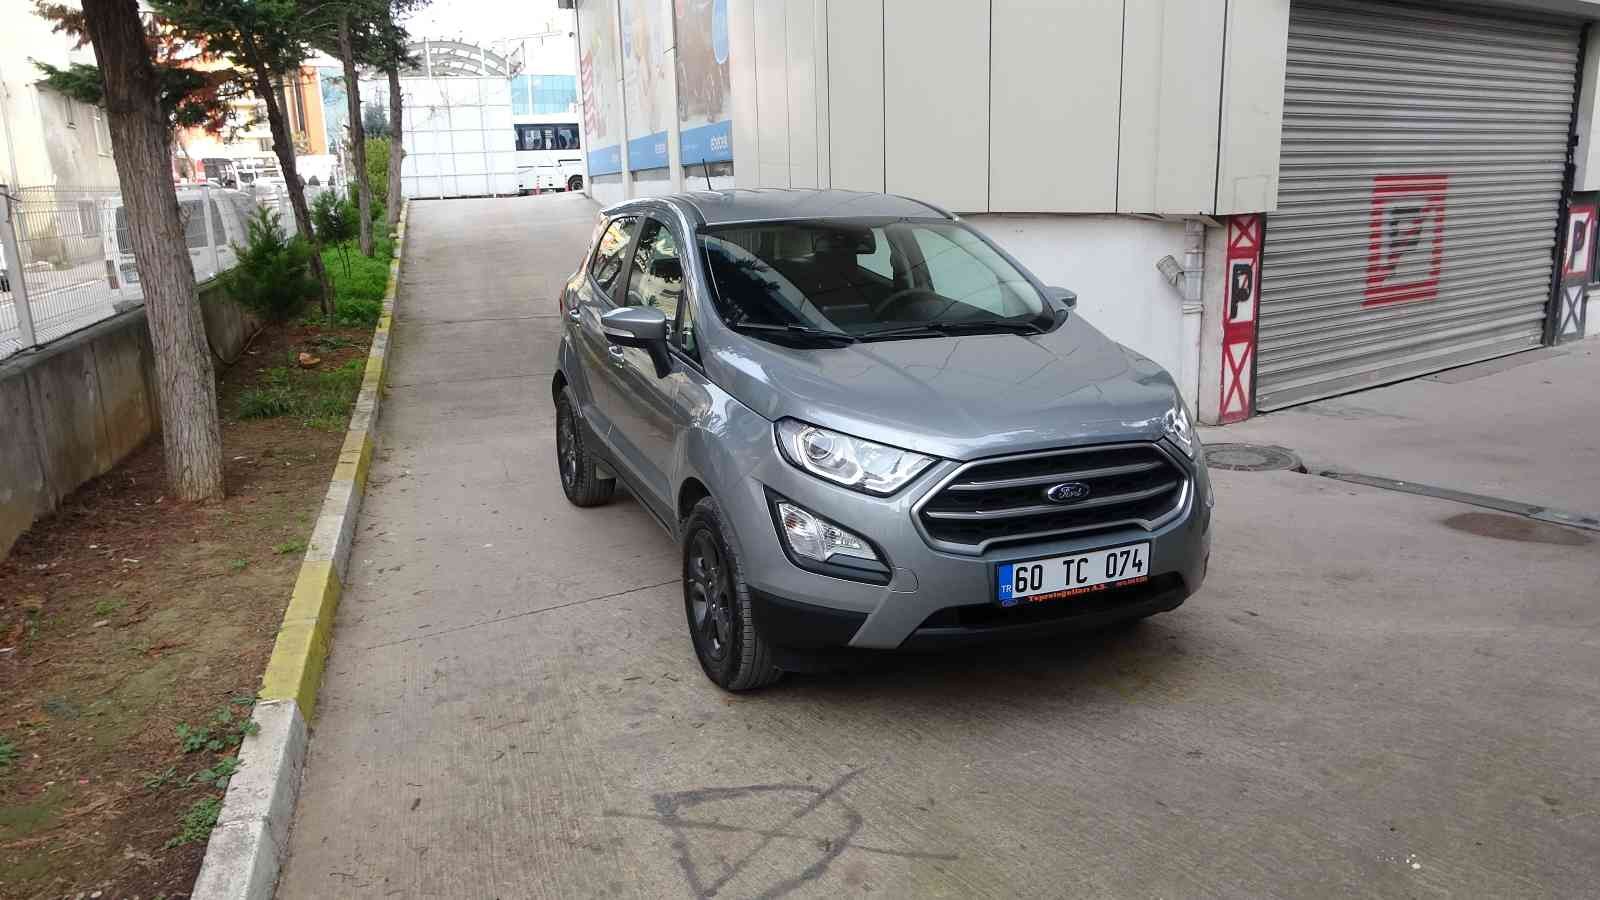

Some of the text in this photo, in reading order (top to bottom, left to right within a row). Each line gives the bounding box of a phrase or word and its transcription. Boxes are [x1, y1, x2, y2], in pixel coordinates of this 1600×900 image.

[1570, 220, 1586, 271] P
[1230, 263, 1252, 319] P
[1059, 486, 1084, 499] Ford
[1000, 584, 1012, 593] TR
[1015, 564, 1043, 593] 60
[1062, 558, 1089, 586] TC
[1105, 549, 1143, 579] 074
